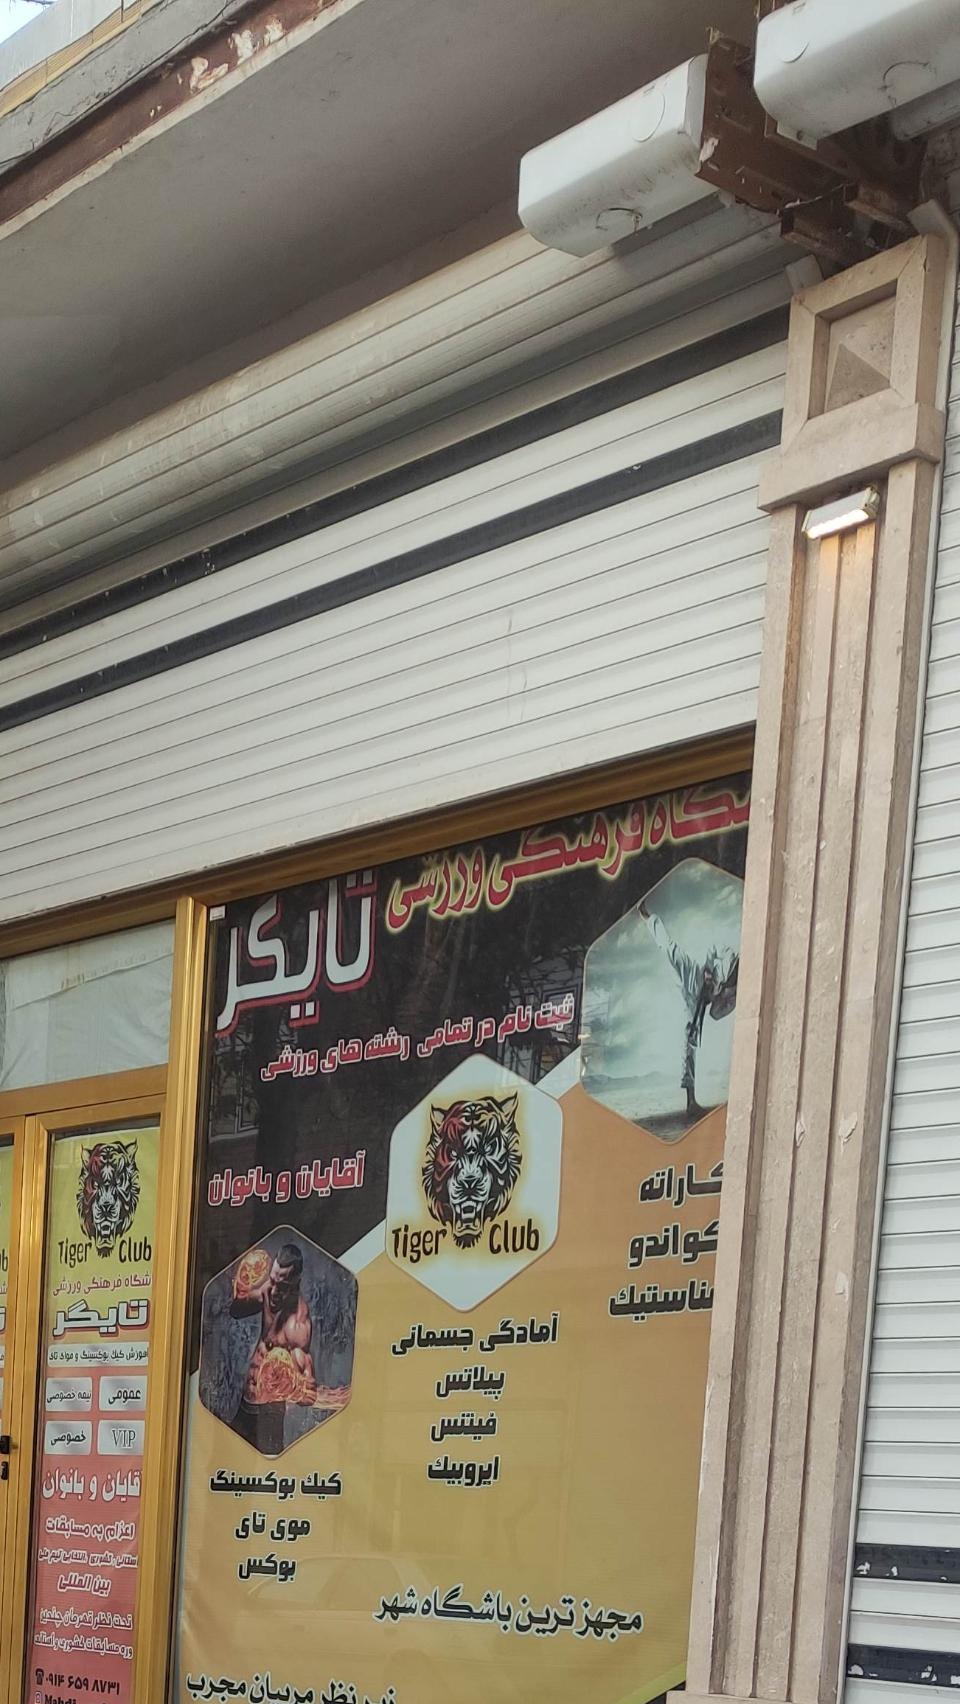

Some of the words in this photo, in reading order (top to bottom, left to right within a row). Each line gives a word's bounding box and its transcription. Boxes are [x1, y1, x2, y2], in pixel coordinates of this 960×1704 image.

[498, 1006, 531, 1042] نام
[535, 993, 574, 1031] ثبت
[364, 1027, 410, 1060] رشته
[417, 1016, 473, 1057] تمامی
[475, 1017, 495, 1047] در
[261, 1046, 318, 1081] ورزشی
[321, 1038, 362, 1072] های
[208, 1166, 272, 1206] بانوان
[276, 1171, 291, 1203] و
[296, 1149, 366, 1198] آقایان
[58, 1238, 92, 1268] Tiger
[119, 1236, 152, 1263] Club
[392, 1224, 447, 1263] Tiger
[489, 1218, 540, 1254] Club
[628, 1219, 720, 1269] کواندو
[52, 1299, 149, 1339] تایگر
[480, 1312, 559, 1352] آمادگی
[392, 1324, 474, 1355] جسمانی
[47, 1388, 76, 1403] خصوصی
[108, 1389, 142, 1405] عمومی
[436, 1366, 505, 1400] پیلاتس
[50, 1429, 87, 1446] خصوصی
[112, 1429, 136, 1447] VIP
[431, 1412, 496, 1442] فیتنس
[42, 1467, 85, 1499] بانوان
[89, 1475, 97, 1500] و
[102, 1470, 141, 1502] قایان
[210, 1469, 296, 1501] بوکسینگ
[46, 1515, 90, 1539] مسابقات
[105, 1520, 135, 1543] اعزام
[235, 1511, 266, 1539] تای
[270, 1518, 311, 1542] موی
[58, 1572, 92, 1592] المللی
[238, 1553, 297, 1583] بوکس
[92, 1575, 111, 1597] بین
[374, 1587, 418, 1622] شهر
[420, 1583, 513, 1633] باشگاه
[515, 1594, 575, 1637] ترین
[574, 1598, 644, 1642] مجهز
[186, 1672, 247, 1702] مجرب
